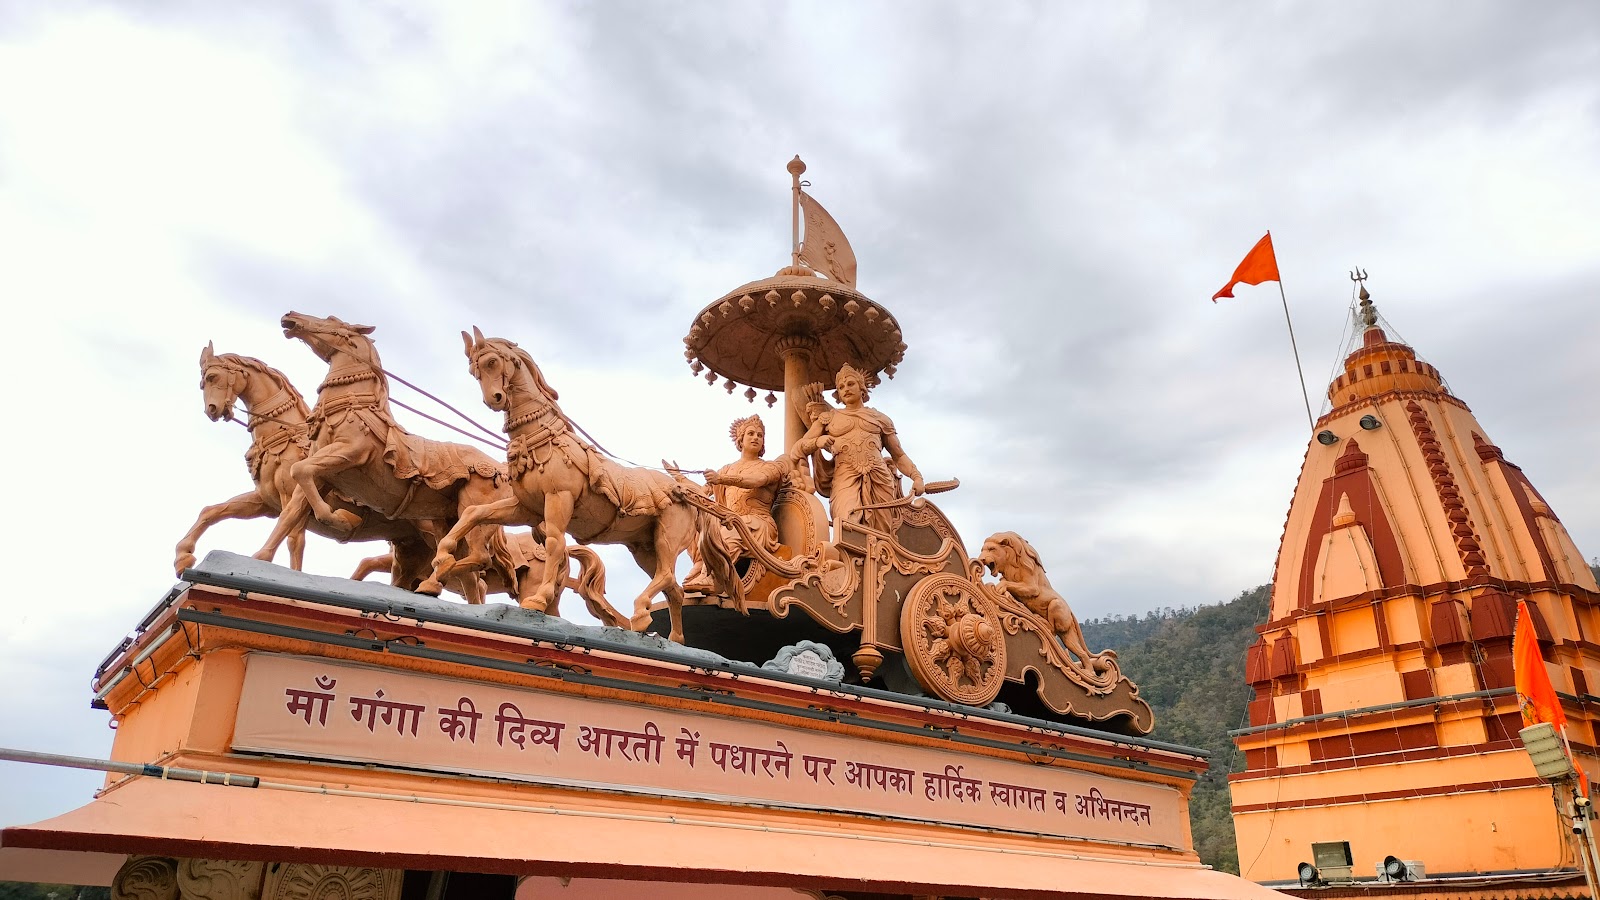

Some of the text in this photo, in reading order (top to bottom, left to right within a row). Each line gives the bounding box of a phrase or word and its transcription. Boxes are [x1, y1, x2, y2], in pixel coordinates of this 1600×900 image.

[285, 675, 1151, 827] माँ गंगा की दिव्य आरती में पधारने पर आपका हार्दिक स्वागत व अभिनन्दन
